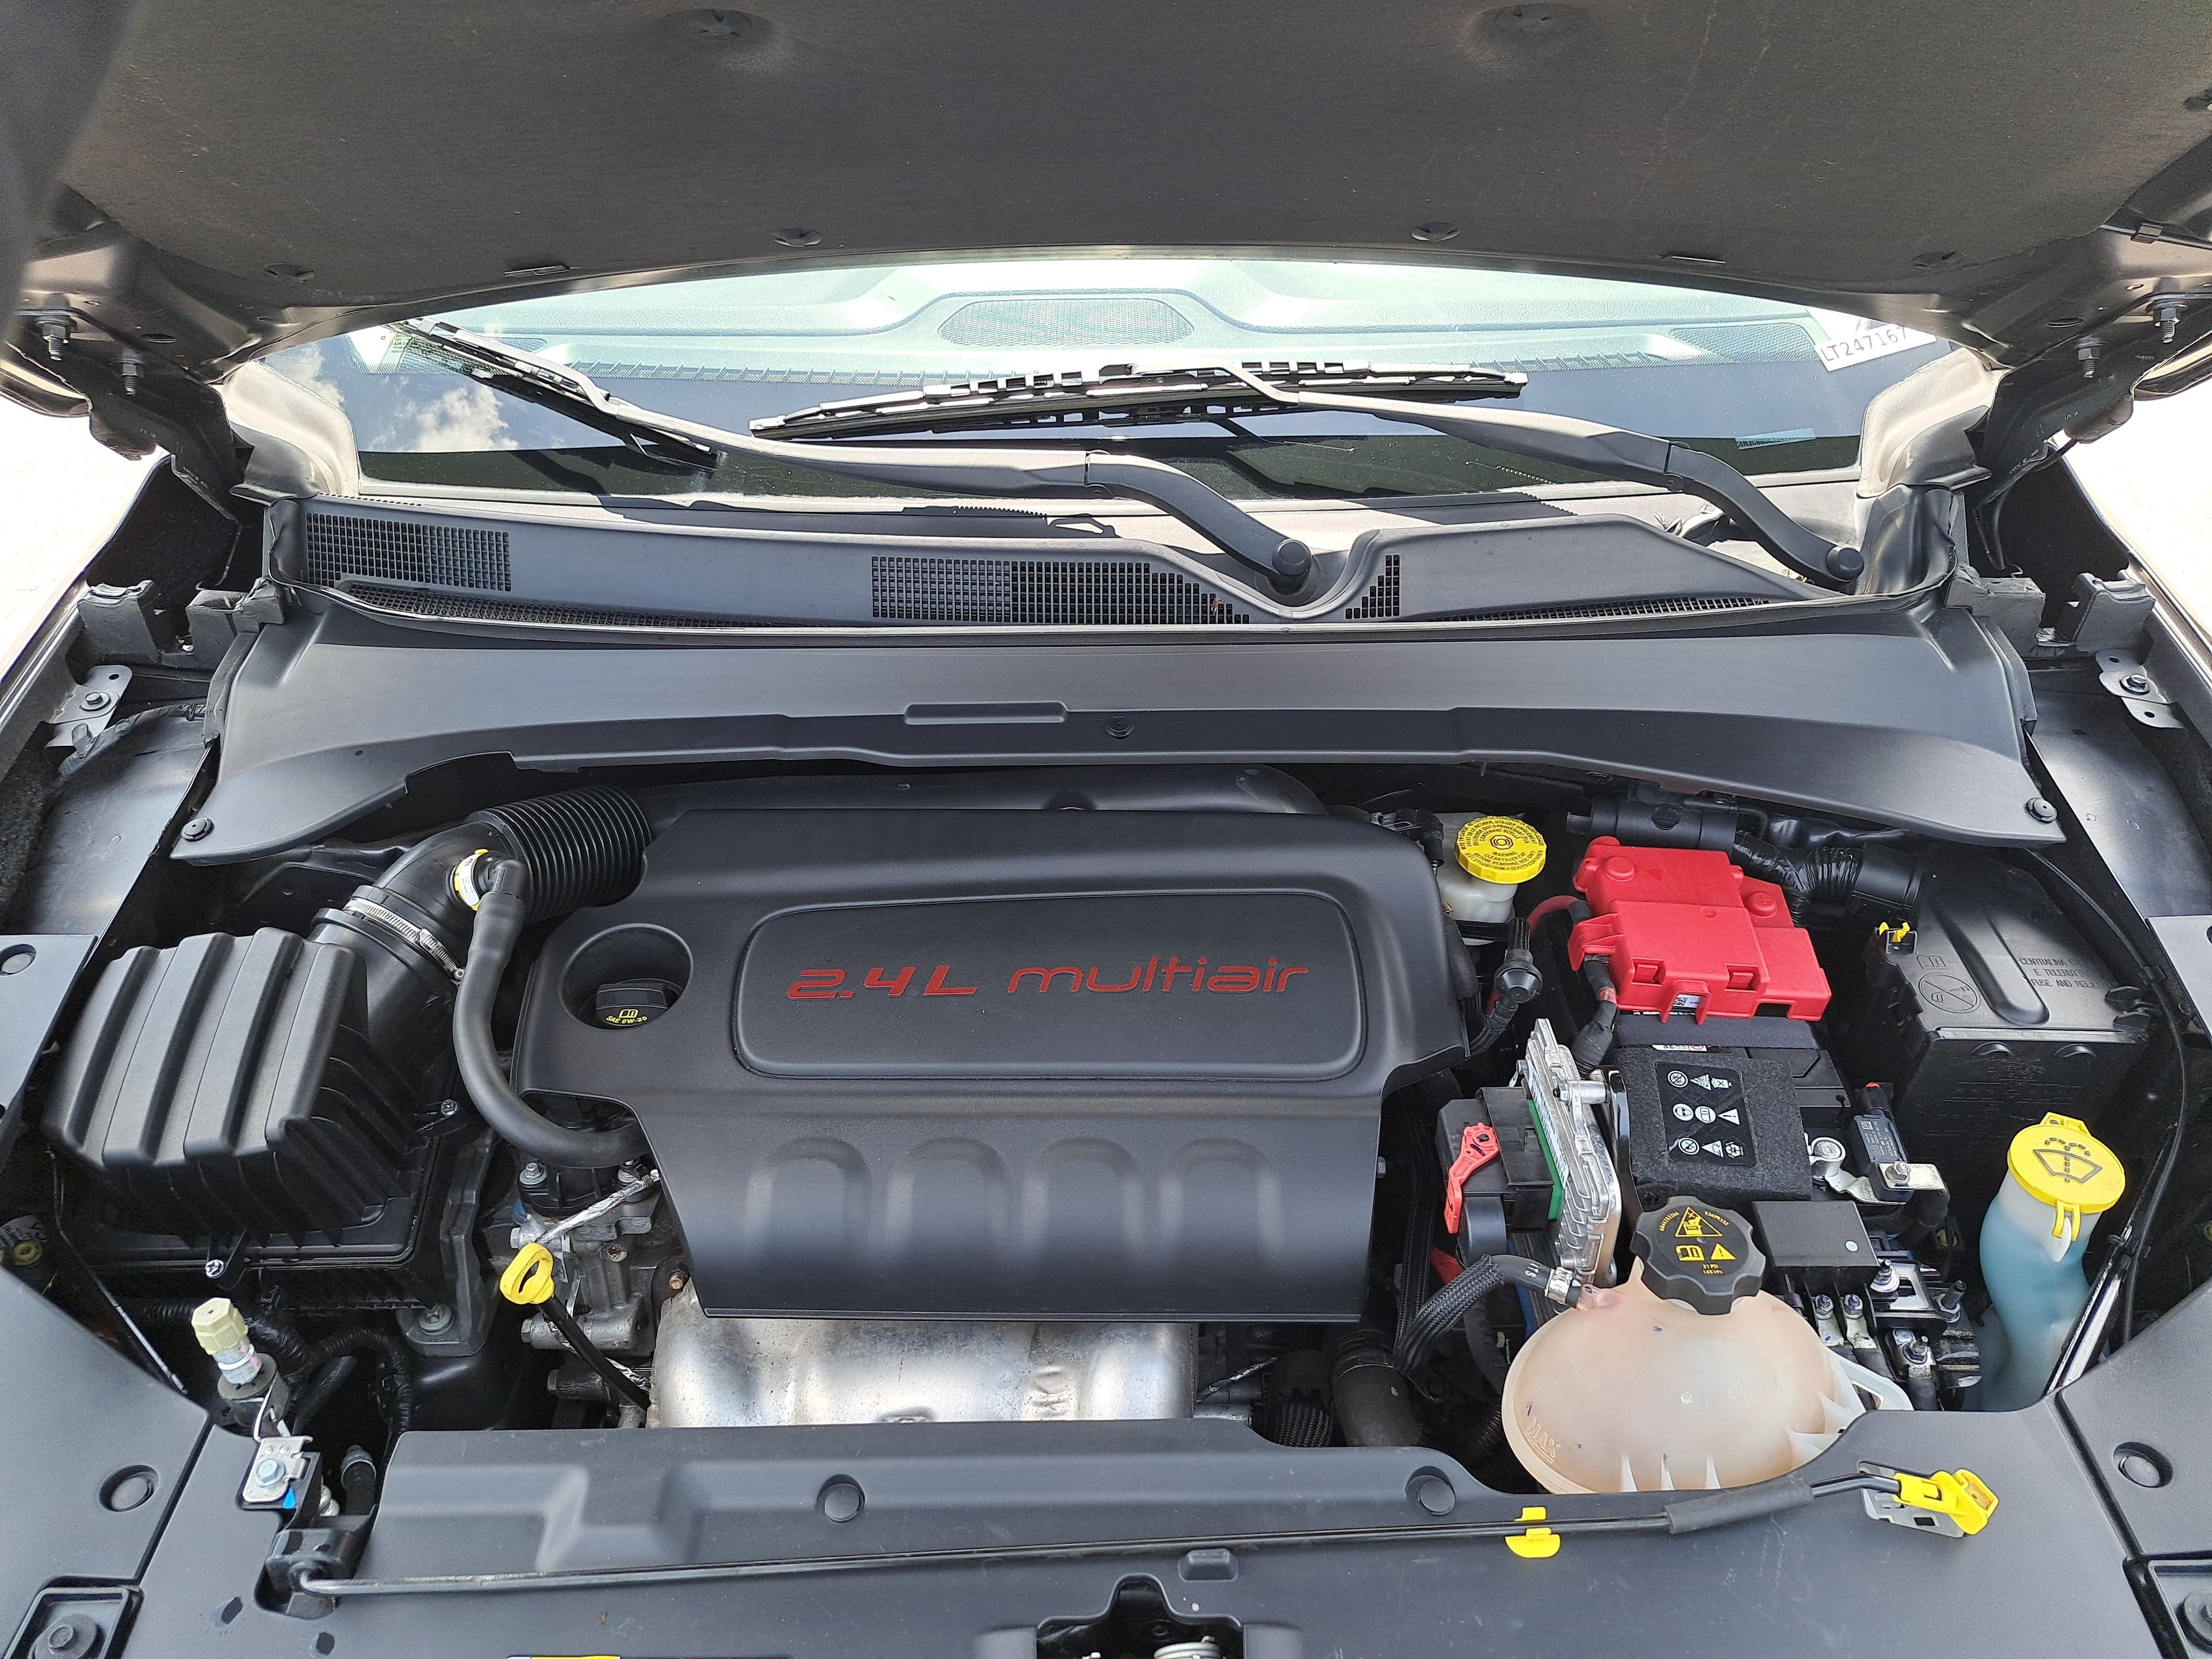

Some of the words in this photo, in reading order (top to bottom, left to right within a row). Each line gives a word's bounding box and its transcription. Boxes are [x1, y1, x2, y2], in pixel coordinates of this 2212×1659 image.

[1820, 327, 1907, 362] LT247167
[1007, 955, 1309, 994] multiair
[2030, 979, 2053, 987] FUSE
[2056, 979, 2073, 988] AND
[606, 1015, 621, 1023] SAE
[1525, 1416, 1562, 1458] MAX
